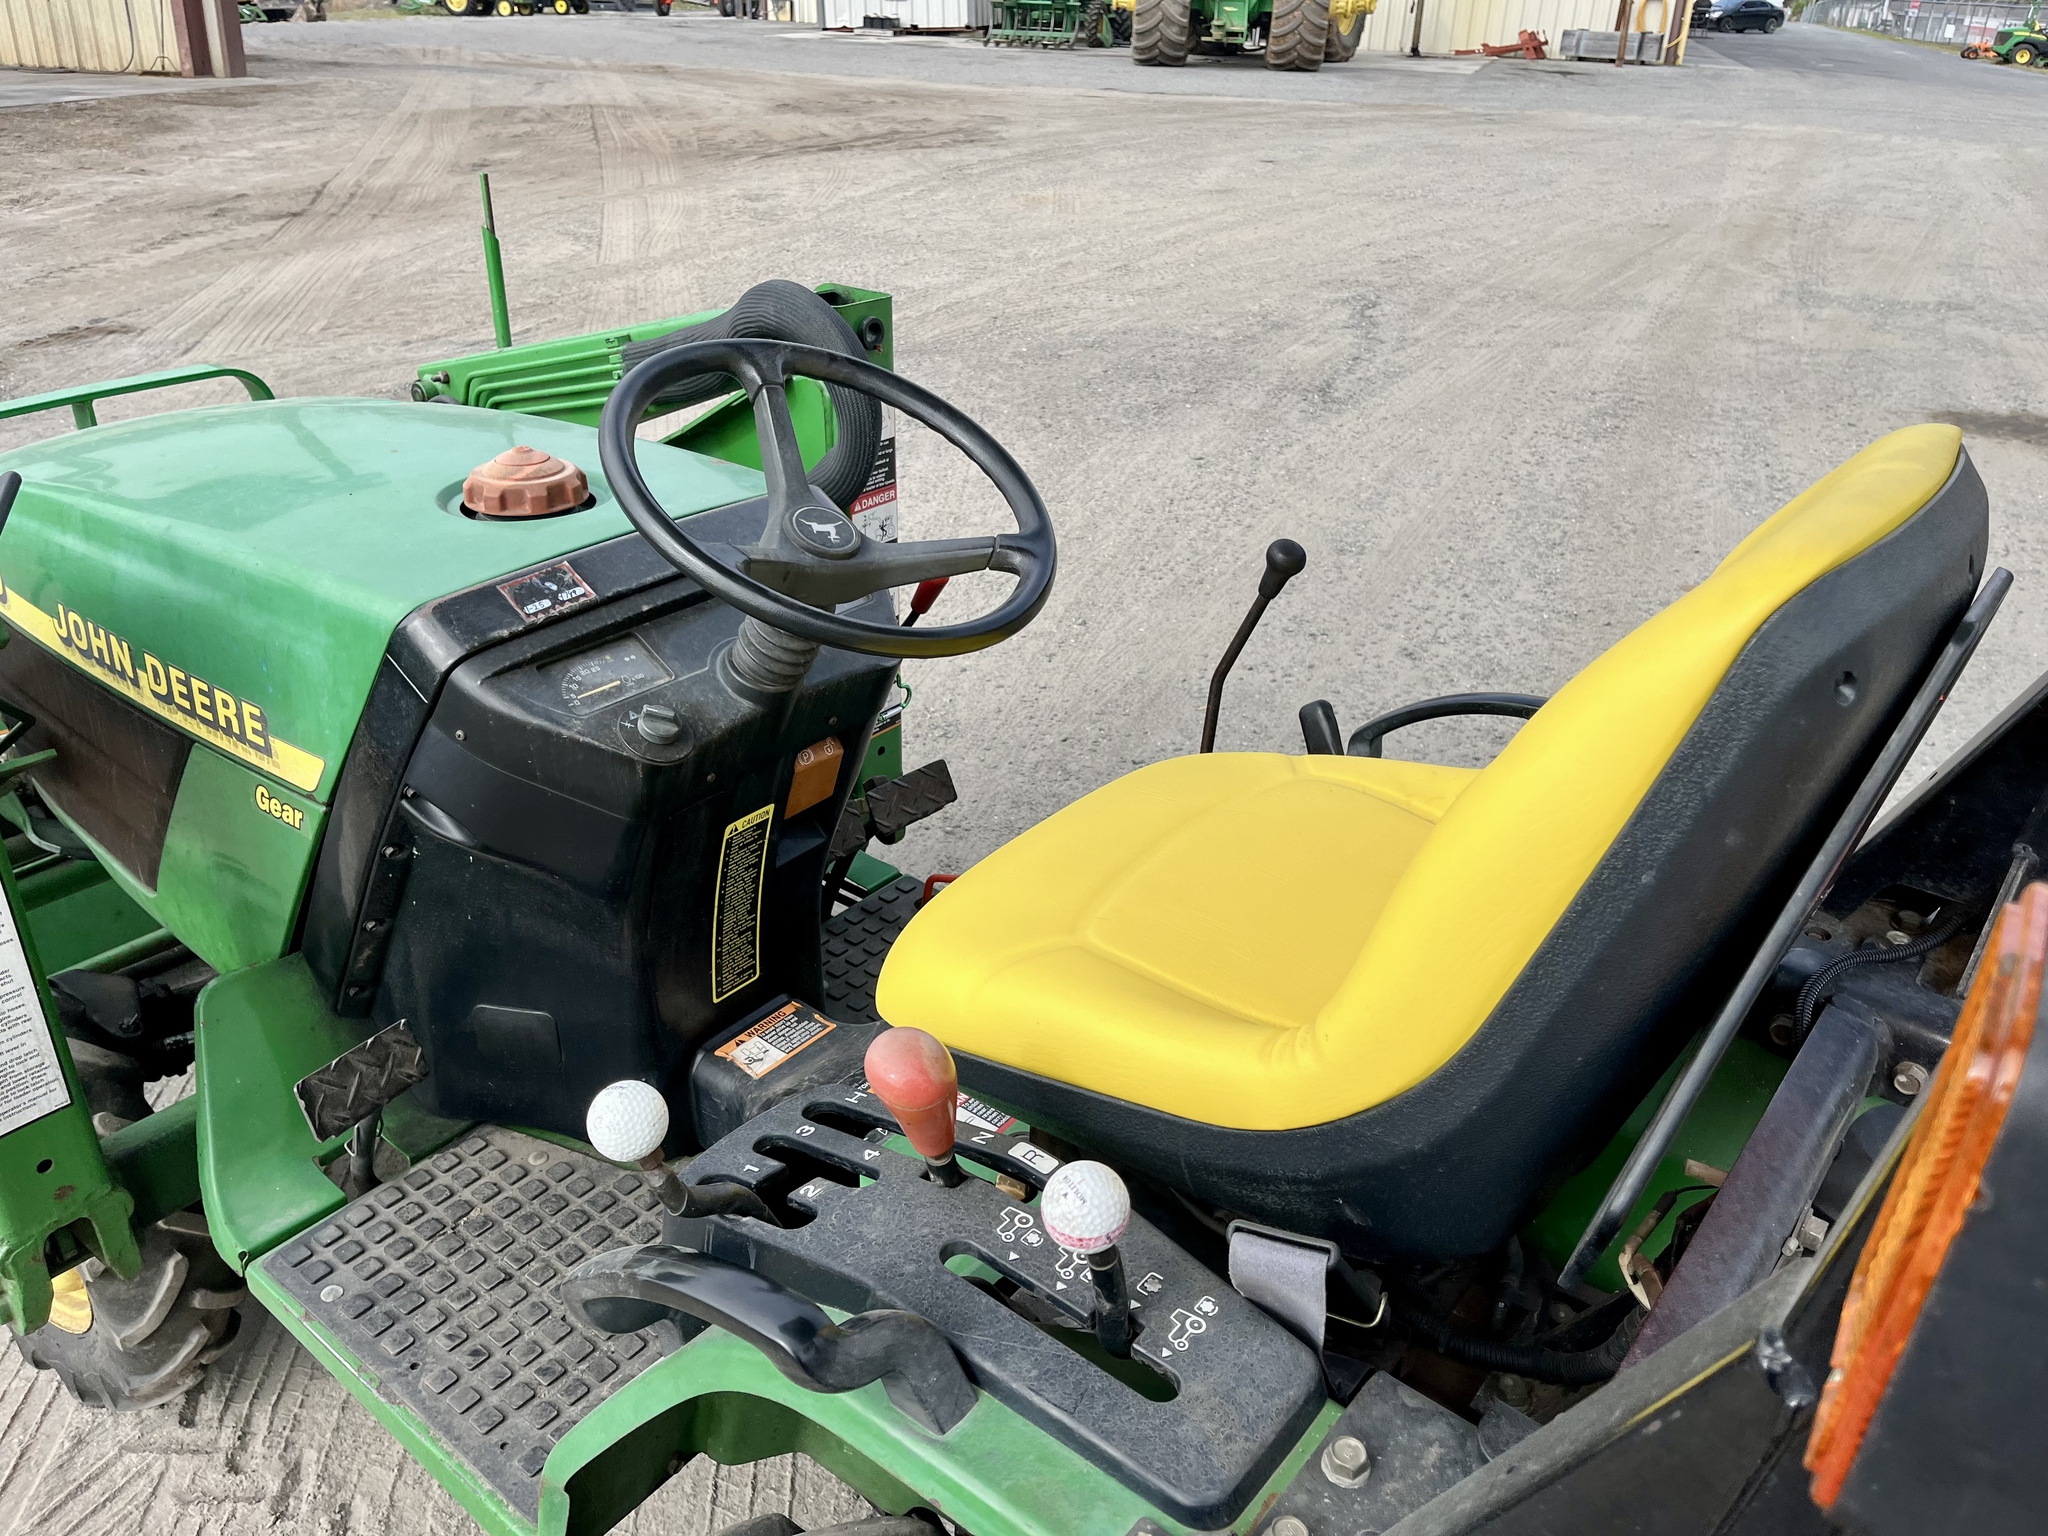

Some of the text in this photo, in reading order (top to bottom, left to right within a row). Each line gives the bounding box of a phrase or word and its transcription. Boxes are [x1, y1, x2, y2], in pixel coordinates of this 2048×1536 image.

[862, 490, 896, 509] DANGER
[52, 601, 270, 754] JOHN DEERE
[254, 785, 304, 831] Gear
[742, 809, 770, 828] CAUTION
[2, 992, 22, 1004] control
[1, 1013, 27, 1029] cylinders
[8, 1021, 20, 1031] with
[21, 1016, 32, 1025] rear
[744, 1010, 787, 1038] WARNING
[6, 1028, 32, 1044] cylinders
[9, 1054, 22, 1065] drop
[24, 1047, 37, 1057] latch
[16, 1058, 27, 1066] lock
[29, 1052, 40, 1060] and
[1, 1064, 50, 1090] and lower retainer
[9, 1071, 22, 1080] from
[24, 1061, 45, 1074] storage
[31, 1071, 46, 1082] Place
[18, 1084, 29, 1093] lock
[31, 1077, 44, 1087] latch
[14, 1089, 31, 1100] loader
[28, 1090, 48, 1103] manual
[844, 1091, 868, 1105] H
[795, 1125, 816, 1138] 3
[971, 1130, 996, 1145] N
[864, 1149, 882, 1161] 4
[1021, 1149, 1046, 1166] R
[742, 1164, 760, 1174] 1
[798, 1185, 820, 1198] 2
